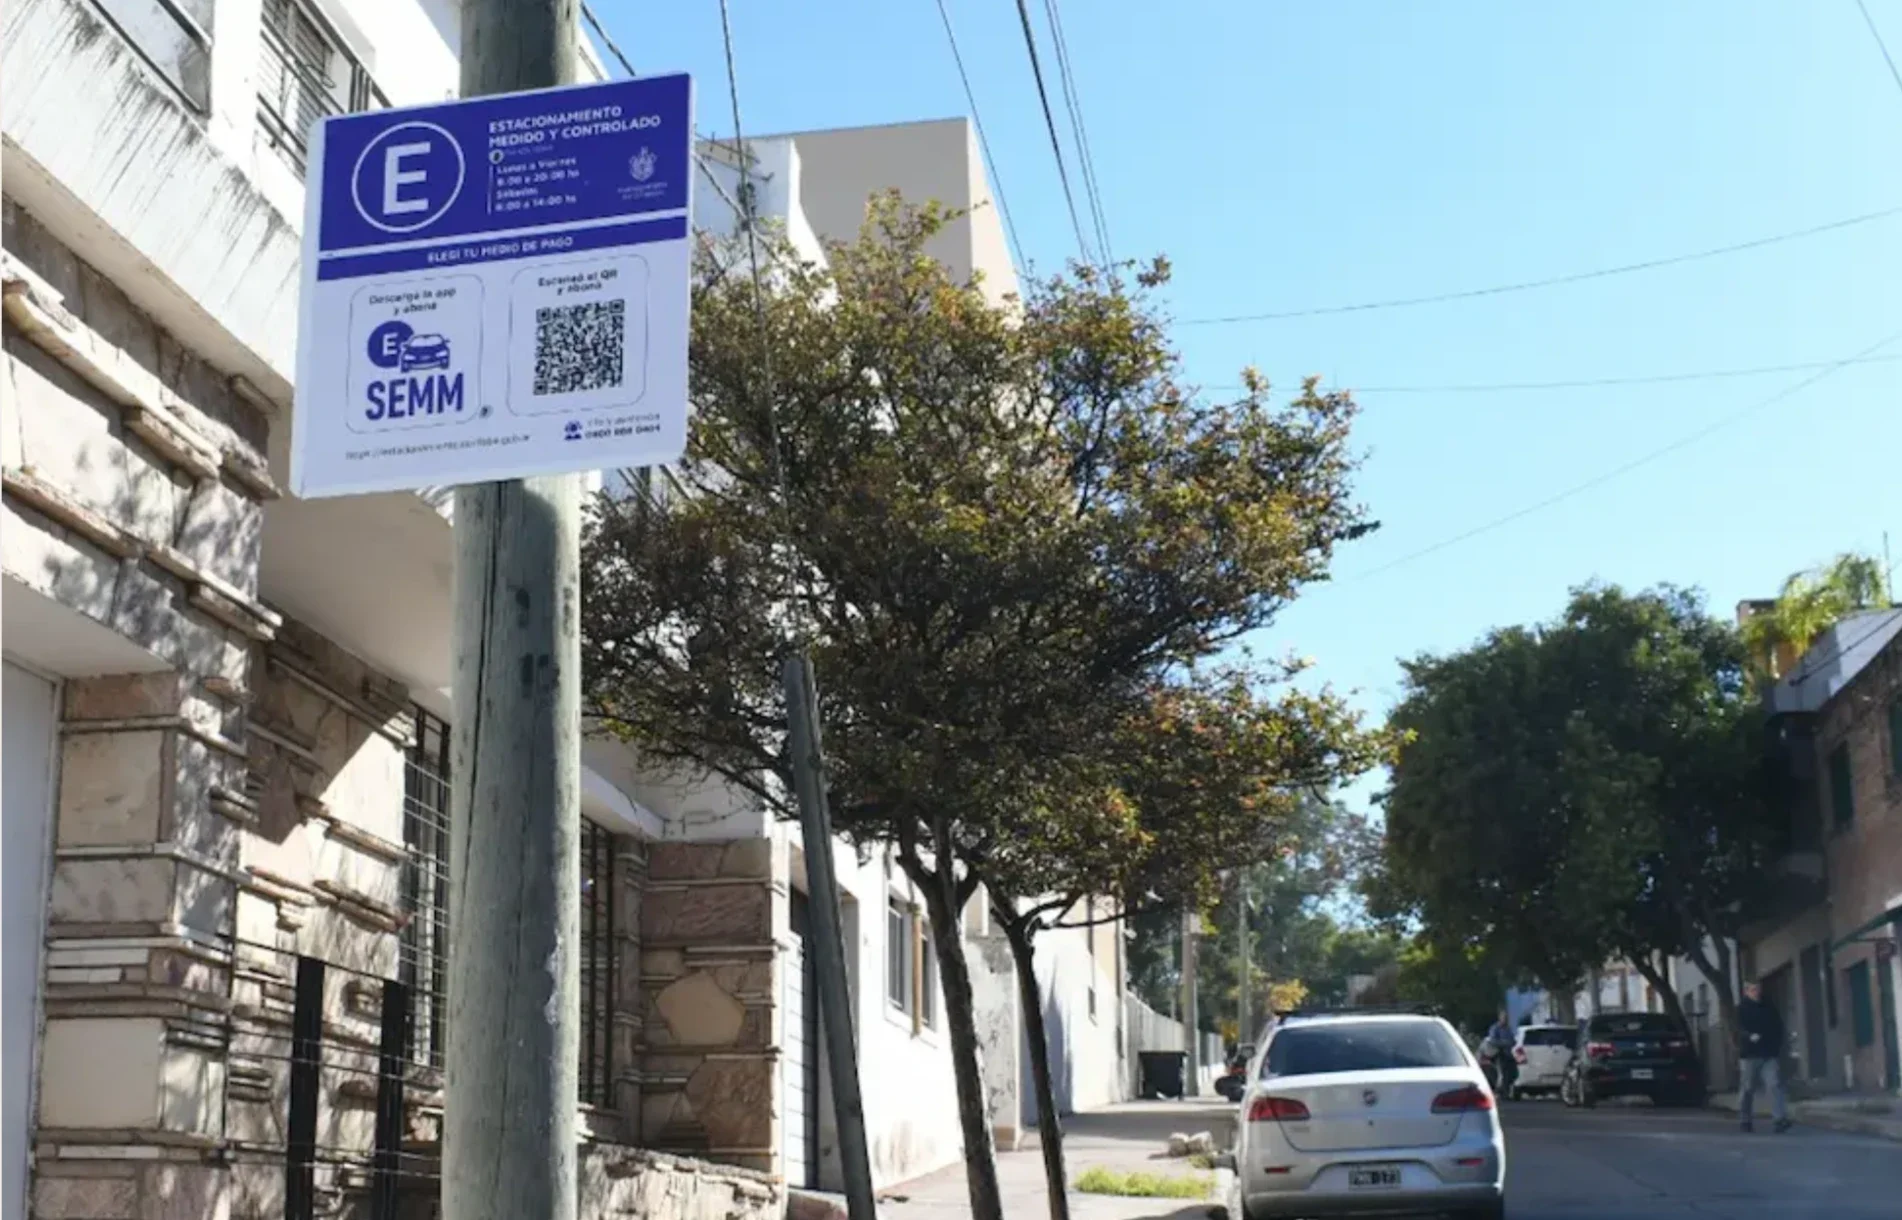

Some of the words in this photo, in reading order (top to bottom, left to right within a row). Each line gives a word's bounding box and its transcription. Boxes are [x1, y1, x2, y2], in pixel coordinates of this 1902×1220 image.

[488, 131, 545, 148] MEDIDO
[549, 129, 559, 141] Y
[561, 115, 662, 139] CONTROLADO
[489, 105, 622, 134] ESTACIONAMIENTO
[383, 141, 431, 215] E
[463, 247, 479, 258] TU
[481, 242, 520, 257] MEDIO
[522, 240, 538, 252] DE
[540, 236, 573, 249] PAGO
[600, 269, 618, 280] QR
[382, 332, 399, 357] E
[365, 372, 464, 422] SEMM
